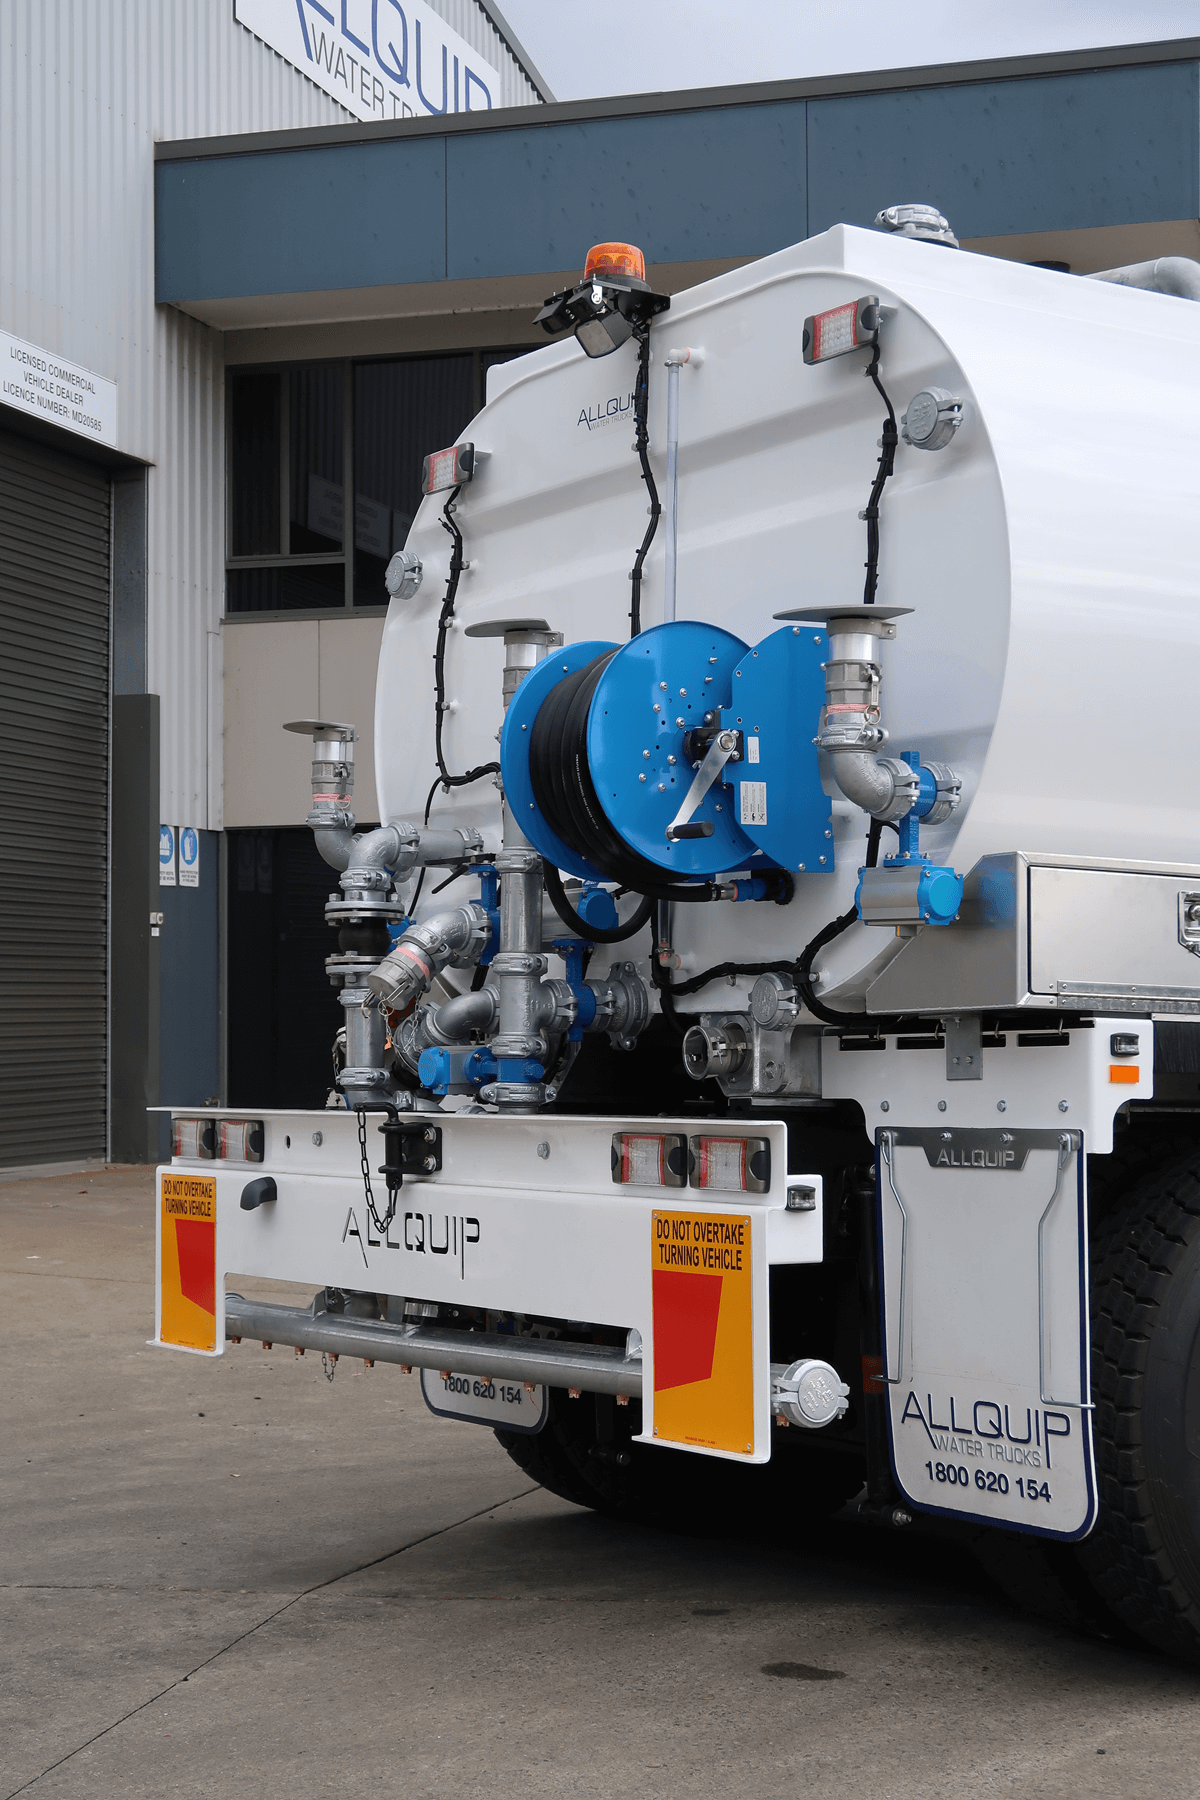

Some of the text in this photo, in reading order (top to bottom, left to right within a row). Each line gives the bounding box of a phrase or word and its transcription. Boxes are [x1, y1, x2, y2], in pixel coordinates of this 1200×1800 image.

[311, 22, 385, 119] WATER
[10, 346, 96, 395] LICENSED COMMERCIAL
[23, 370, 84, 407] VEHICLE DEALER
[3, 380, 102, 432] LICENCE NUMBER: MD20585
[577, 391, 634, 431] ALLQUI
[590, 410, 633, 430] WATER TRUCKS
[936, 1148, 1015, 1168] ALLQUIP
[164, 1179, 212, 1199] DO NOT OVERTAKE
[165, 1198, 211, 1217] TURNING VEHICLE
[341, 1206, 480, 1280] ALLQUIP
[656, 1218, 744, 1246] DO NOT OVERTAKE
[658, 1243, 743, 1271] TURNING VEHICLE
[443, 1376, 522, 1405] 1800 620 154
[901, 1390, 1071, 1469] ALLQUIP
[935, 1433, 1042, 1468] WATER TRUCKS
[925, 1460, 1052, 1503] 1800 620 154
